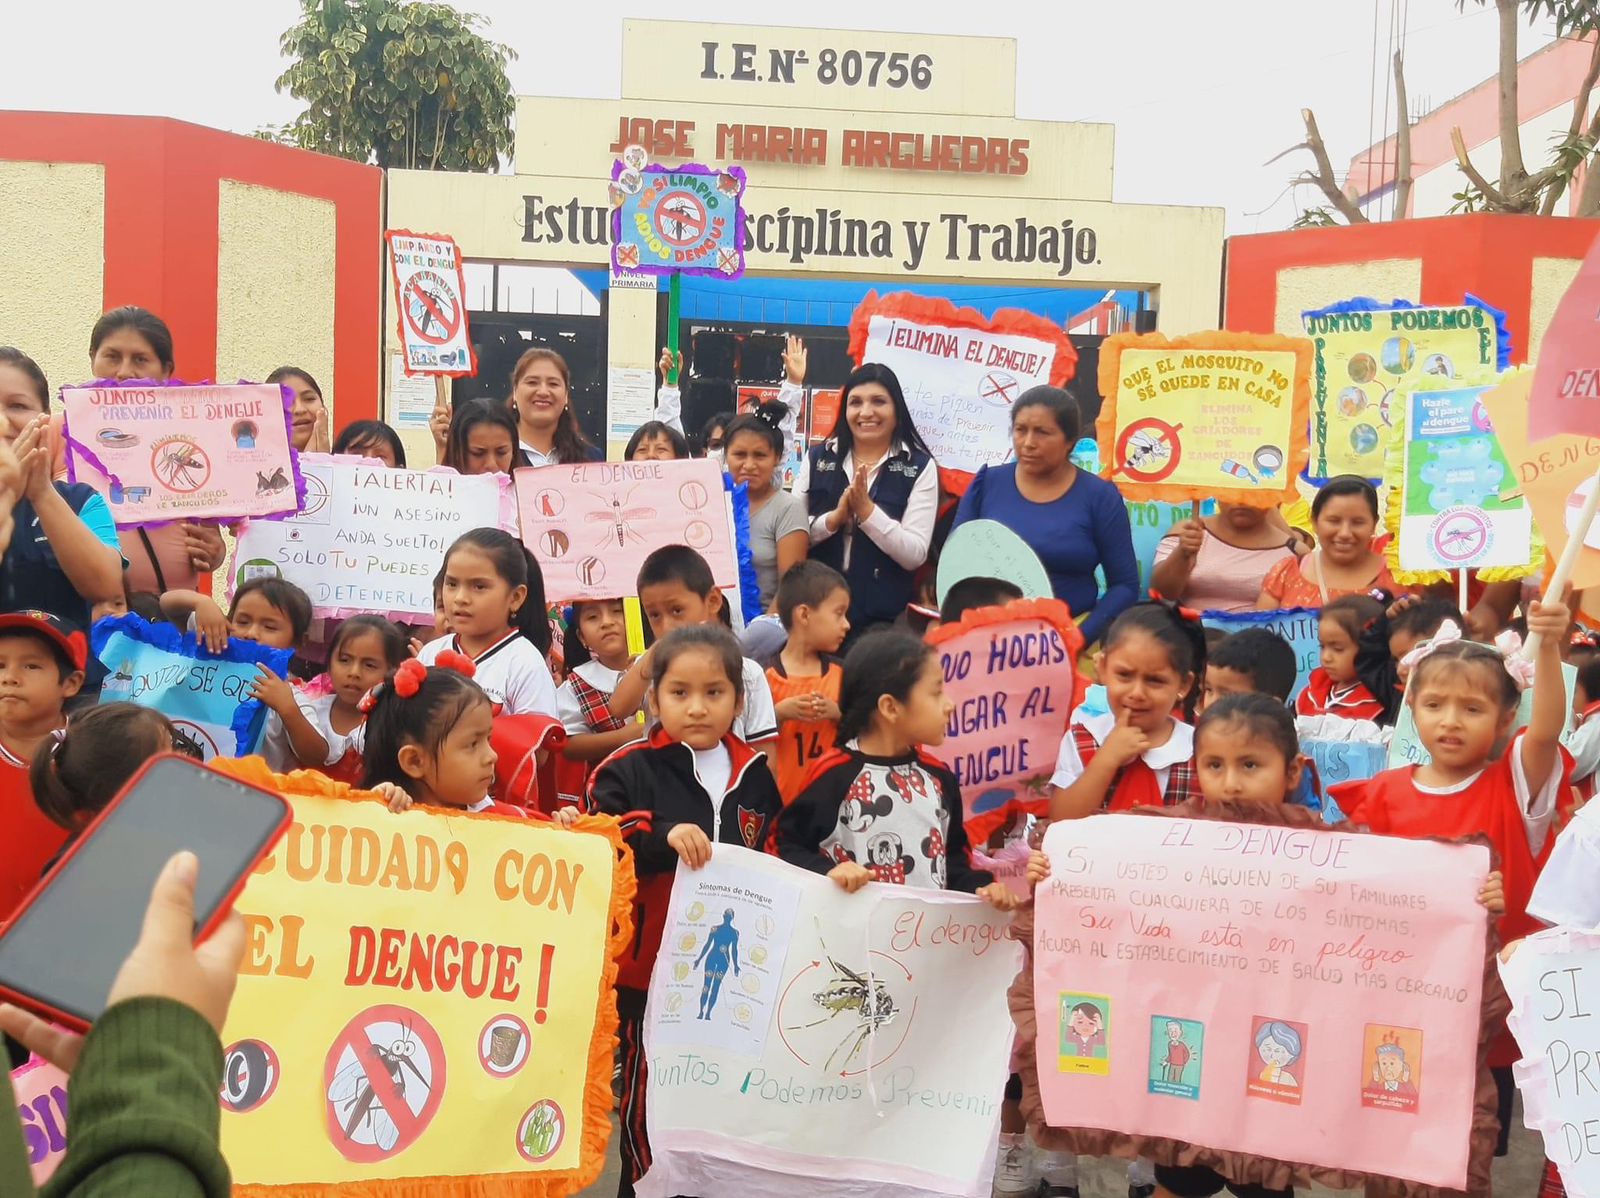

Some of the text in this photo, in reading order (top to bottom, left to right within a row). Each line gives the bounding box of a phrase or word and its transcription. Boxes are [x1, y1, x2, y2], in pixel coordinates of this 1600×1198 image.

[817, 48, 933, 90] 80756
[609, 116, 1030, 177] JOSE MARIA ARGUEDAS
[670, 174, 719, 210] LIMPIO
[445, 246, 452, 257] Y
[521, 196, 1103, 277] Estu sciplina y Trabajo.
[634, 212, 726, 263] ADIOS DENGUE
[393, 253, 454, 271] CON EL DENGU
[612, 279, 655, 288] PRIMARIA
[1307, 307, 1484, 336] JUNTOS PODEMOS
[886, 320, 1047, 378] ¡ELIMINA EL DENGUE!
[1477, 326, 1491, 365] EL
[1123, 354, 1289, 391] QUE EL MOSQUITO NO
[90, 389, 156, 405] JUNTOS
[1159, 374, 1211, 394] QUEDE
[1217, 376, 1240, 391] EN
[1244, 380, 1283, 408] CASA
[1315, 337, 1328, 478] PREVENIR
[181, 404, 198, 420] EL
[205, 400, 263, 421] DENGUE
[1213, 416, 1239, 426] LOS
[1428, 407, 1465, 418] el pare
[1430, 416, 1470, 427] dengue
[915, 424, 945, 438] ngue,
[353, 467, 453, 499] ¡ALERTA!
[571, 464, 664, 485] EL DENGUE
[353, 497, 379, 517] ¡UN
[335, 528, 446, 554] ANDA SUELTO!
[278, 548, 429, 576] SOLO TU PUEDES
[189, 664, 220, 694] SE
[944, 686, 1056, 739] UGAR AL
[951, 738, 1029, 789] ENGUE
[1160, 821, 1353, 870] EL DENGUE
[494, 848, 584, 915] CON
[733, 886, 743, 895] de
[744, 888, 773, 905] Dengue
[1115, 860, 1169, 883] USTED
[1198, 863, 1271, 889] ALGUIEN
[1279, 872, 1301, 891] DE
[1314, 877, 1338, 896] SU
[1350, 882, 1428, 911] FAMILIARES
[1050, 879, 1116, 904] PRESENTA
[1129, 888, 1231, 916] CUALQUIERA
[1240, 898, 1264, 917] DE
[1273, 902, 1308, 923] LOS
[890, 911, 922, 952] El
[1079, 906, 1113, 931] Su
[1265, 935, 1296, 955] en
[1316, 934, 1413, 970] peligro
[1039, 929, 1081, 955] ACUDA
[1089, 940, 1109, 959] AL
[1116, 941, 1249, 970] ESTABLECIMIENTO
[1258, 957, 1280, 975] DE
[1292, 960, 1343, 985] SALUD
[1395, 976, 1468, 1003] CERCANO
[1539, 967, 1592, 1022] SI
[740, 1067, 863, 1104] Podemos
[881, 1064, 996, 1118] Prevenir
